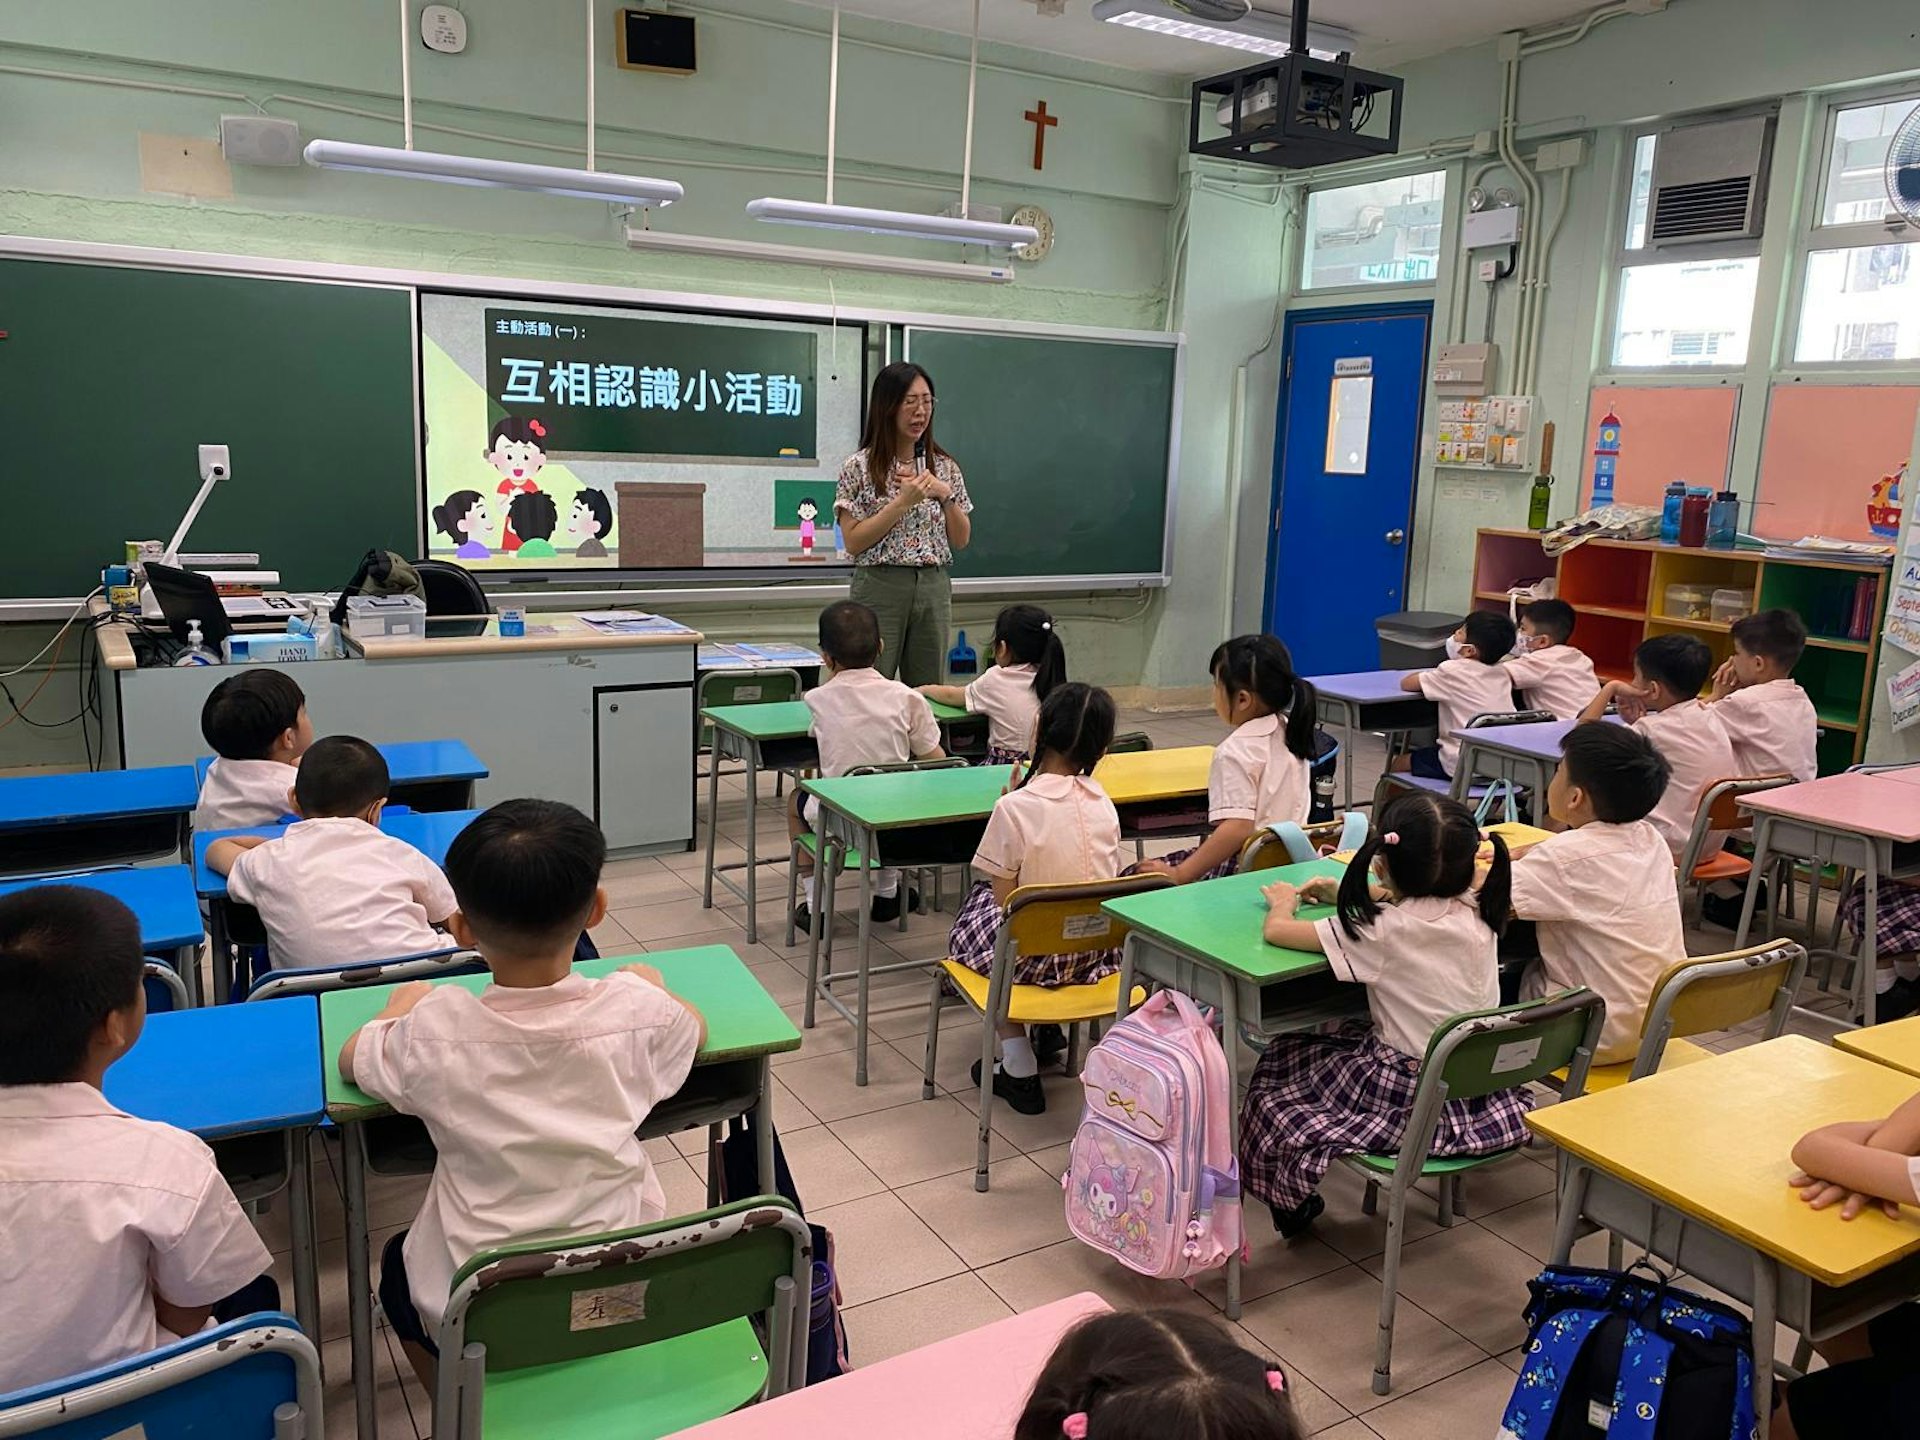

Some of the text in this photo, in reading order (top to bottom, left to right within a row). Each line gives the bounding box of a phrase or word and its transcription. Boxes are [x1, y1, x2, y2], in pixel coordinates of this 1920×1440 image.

[501, 358, 802, 417] 互相認識小活動
[280, 647, 307, 656] HAND
